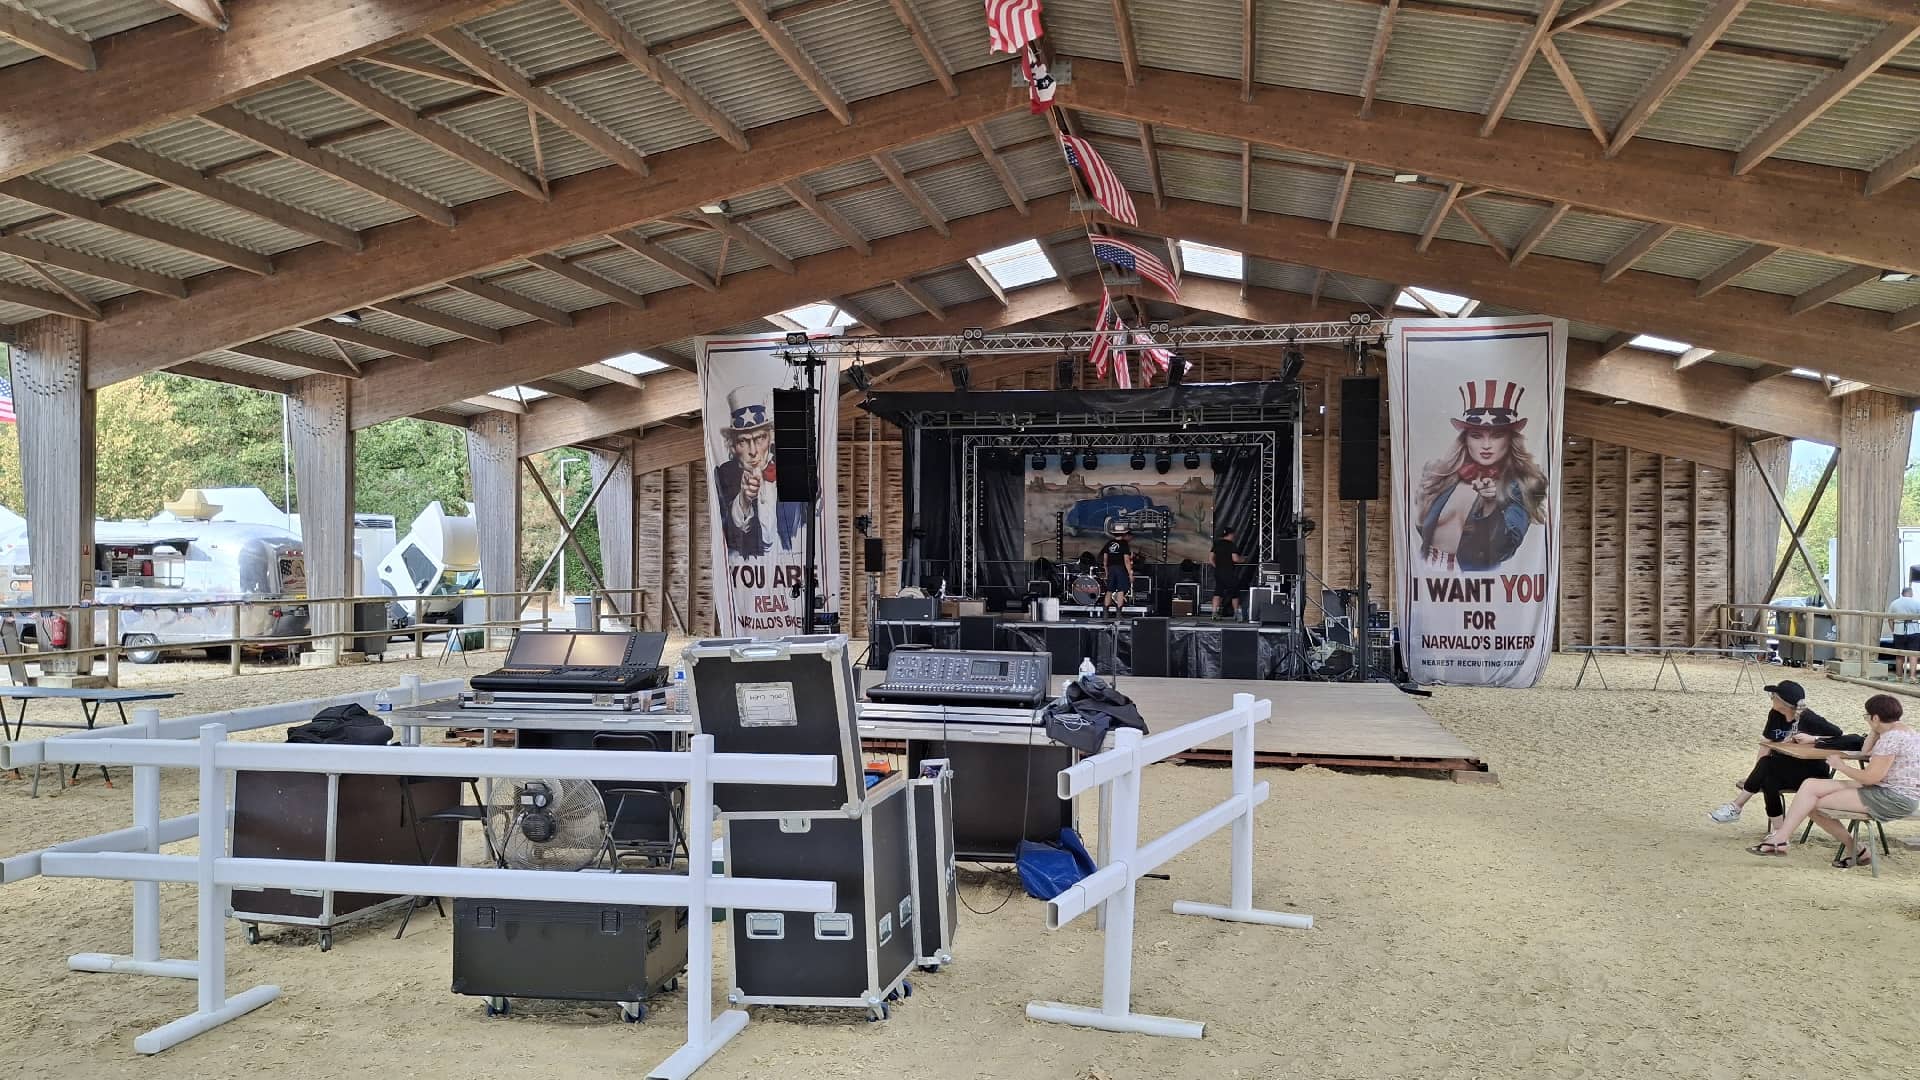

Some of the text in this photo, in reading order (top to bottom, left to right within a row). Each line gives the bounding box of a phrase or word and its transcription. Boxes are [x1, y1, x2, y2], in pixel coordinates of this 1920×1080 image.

[729, 565, 765, 588] YOU
[1413, 573, 1545, 603] I WANT YOU
[754, 594, 789, 613] REAL
[1463, 611, 1496, 630] FOR
[1421, 635, 1536, 650] NARVALO'S BIKERS
[1421, 659, 1454, 667] NEAREST
[1457, 660, 1501, 668] RECRUITING
